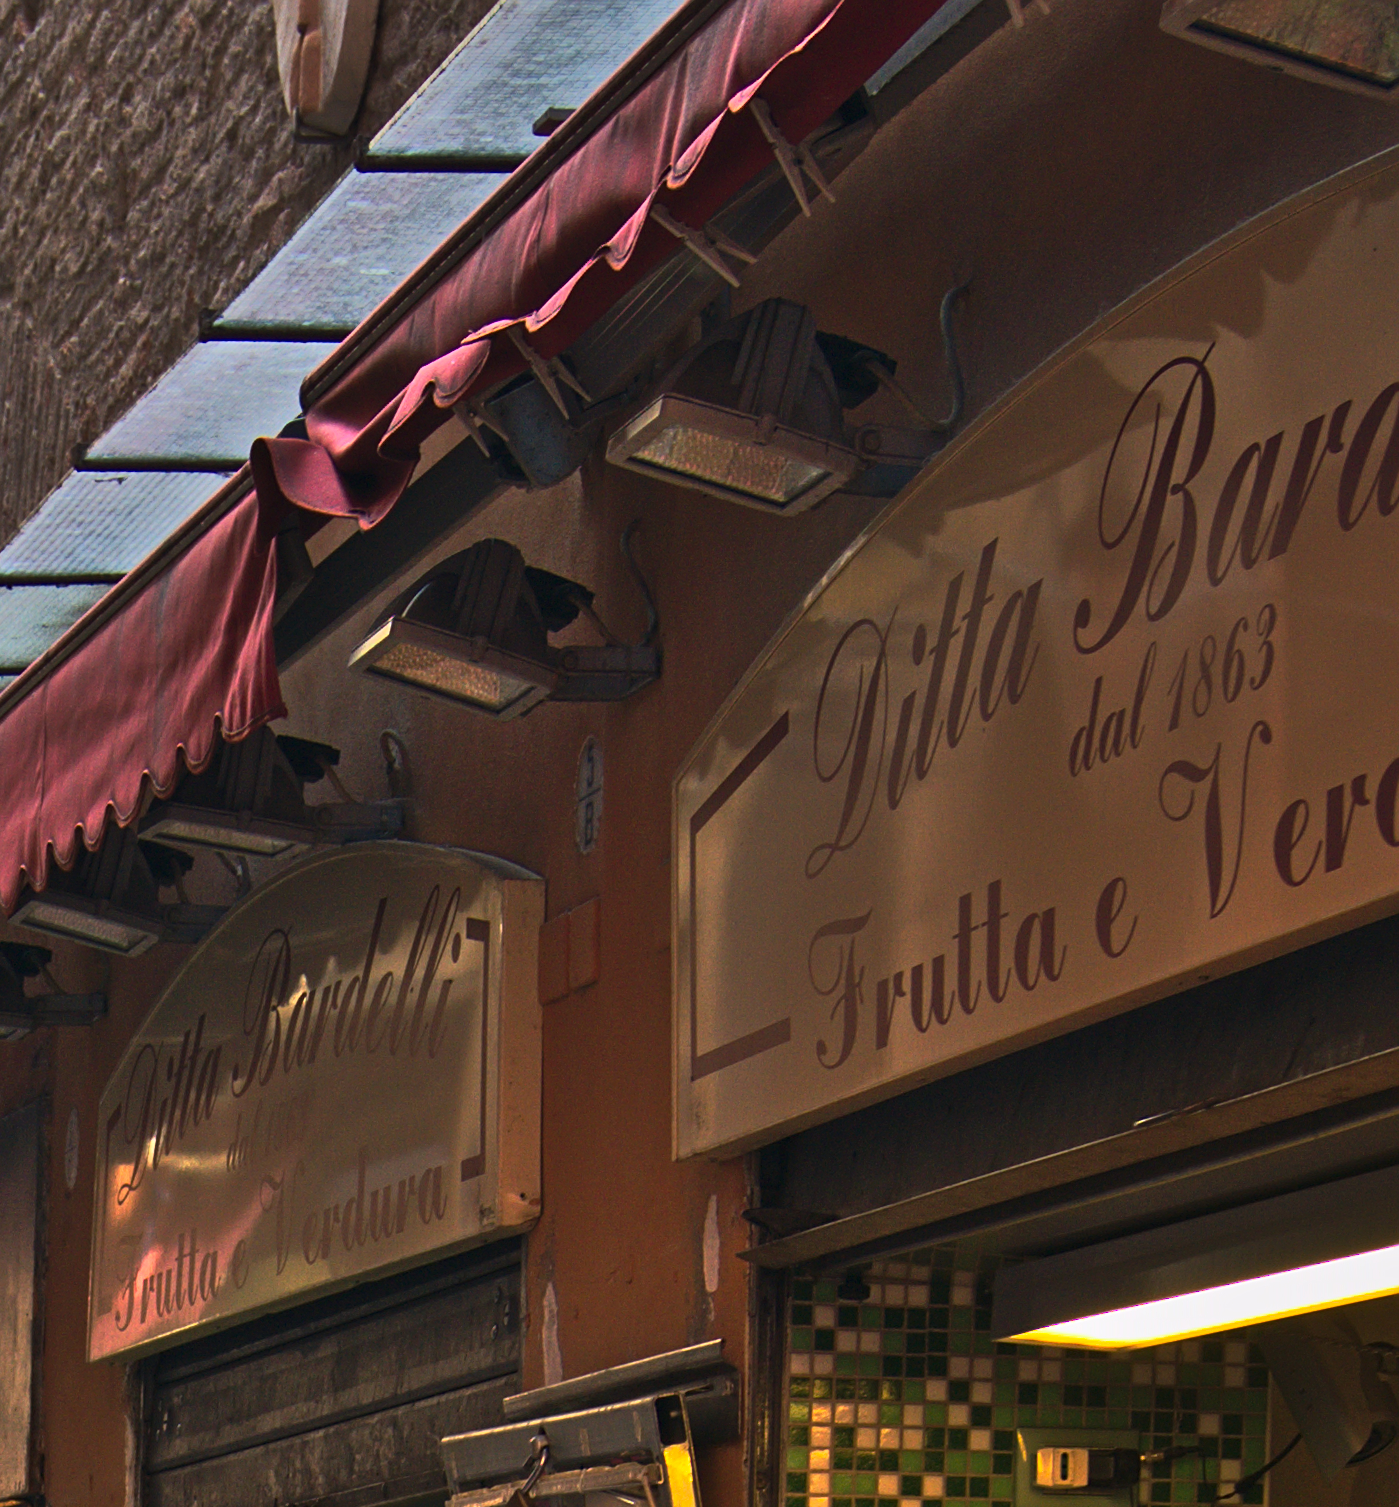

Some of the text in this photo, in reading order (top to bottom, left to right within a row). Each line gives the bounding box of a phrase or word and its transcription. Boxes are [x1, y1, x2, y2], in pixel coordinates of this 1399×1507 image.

[807, 537, 1043, 878] Ditta
[1069, 604, 1279, 778] dal 1863
[118, 884, 461, 1205] Ditta Bardelli
[807, 880, 1066, 1067] Frutta
[1096, 876, 1138, 958] e
[115, 1149, 448, 1331] Frutta e Verdura
